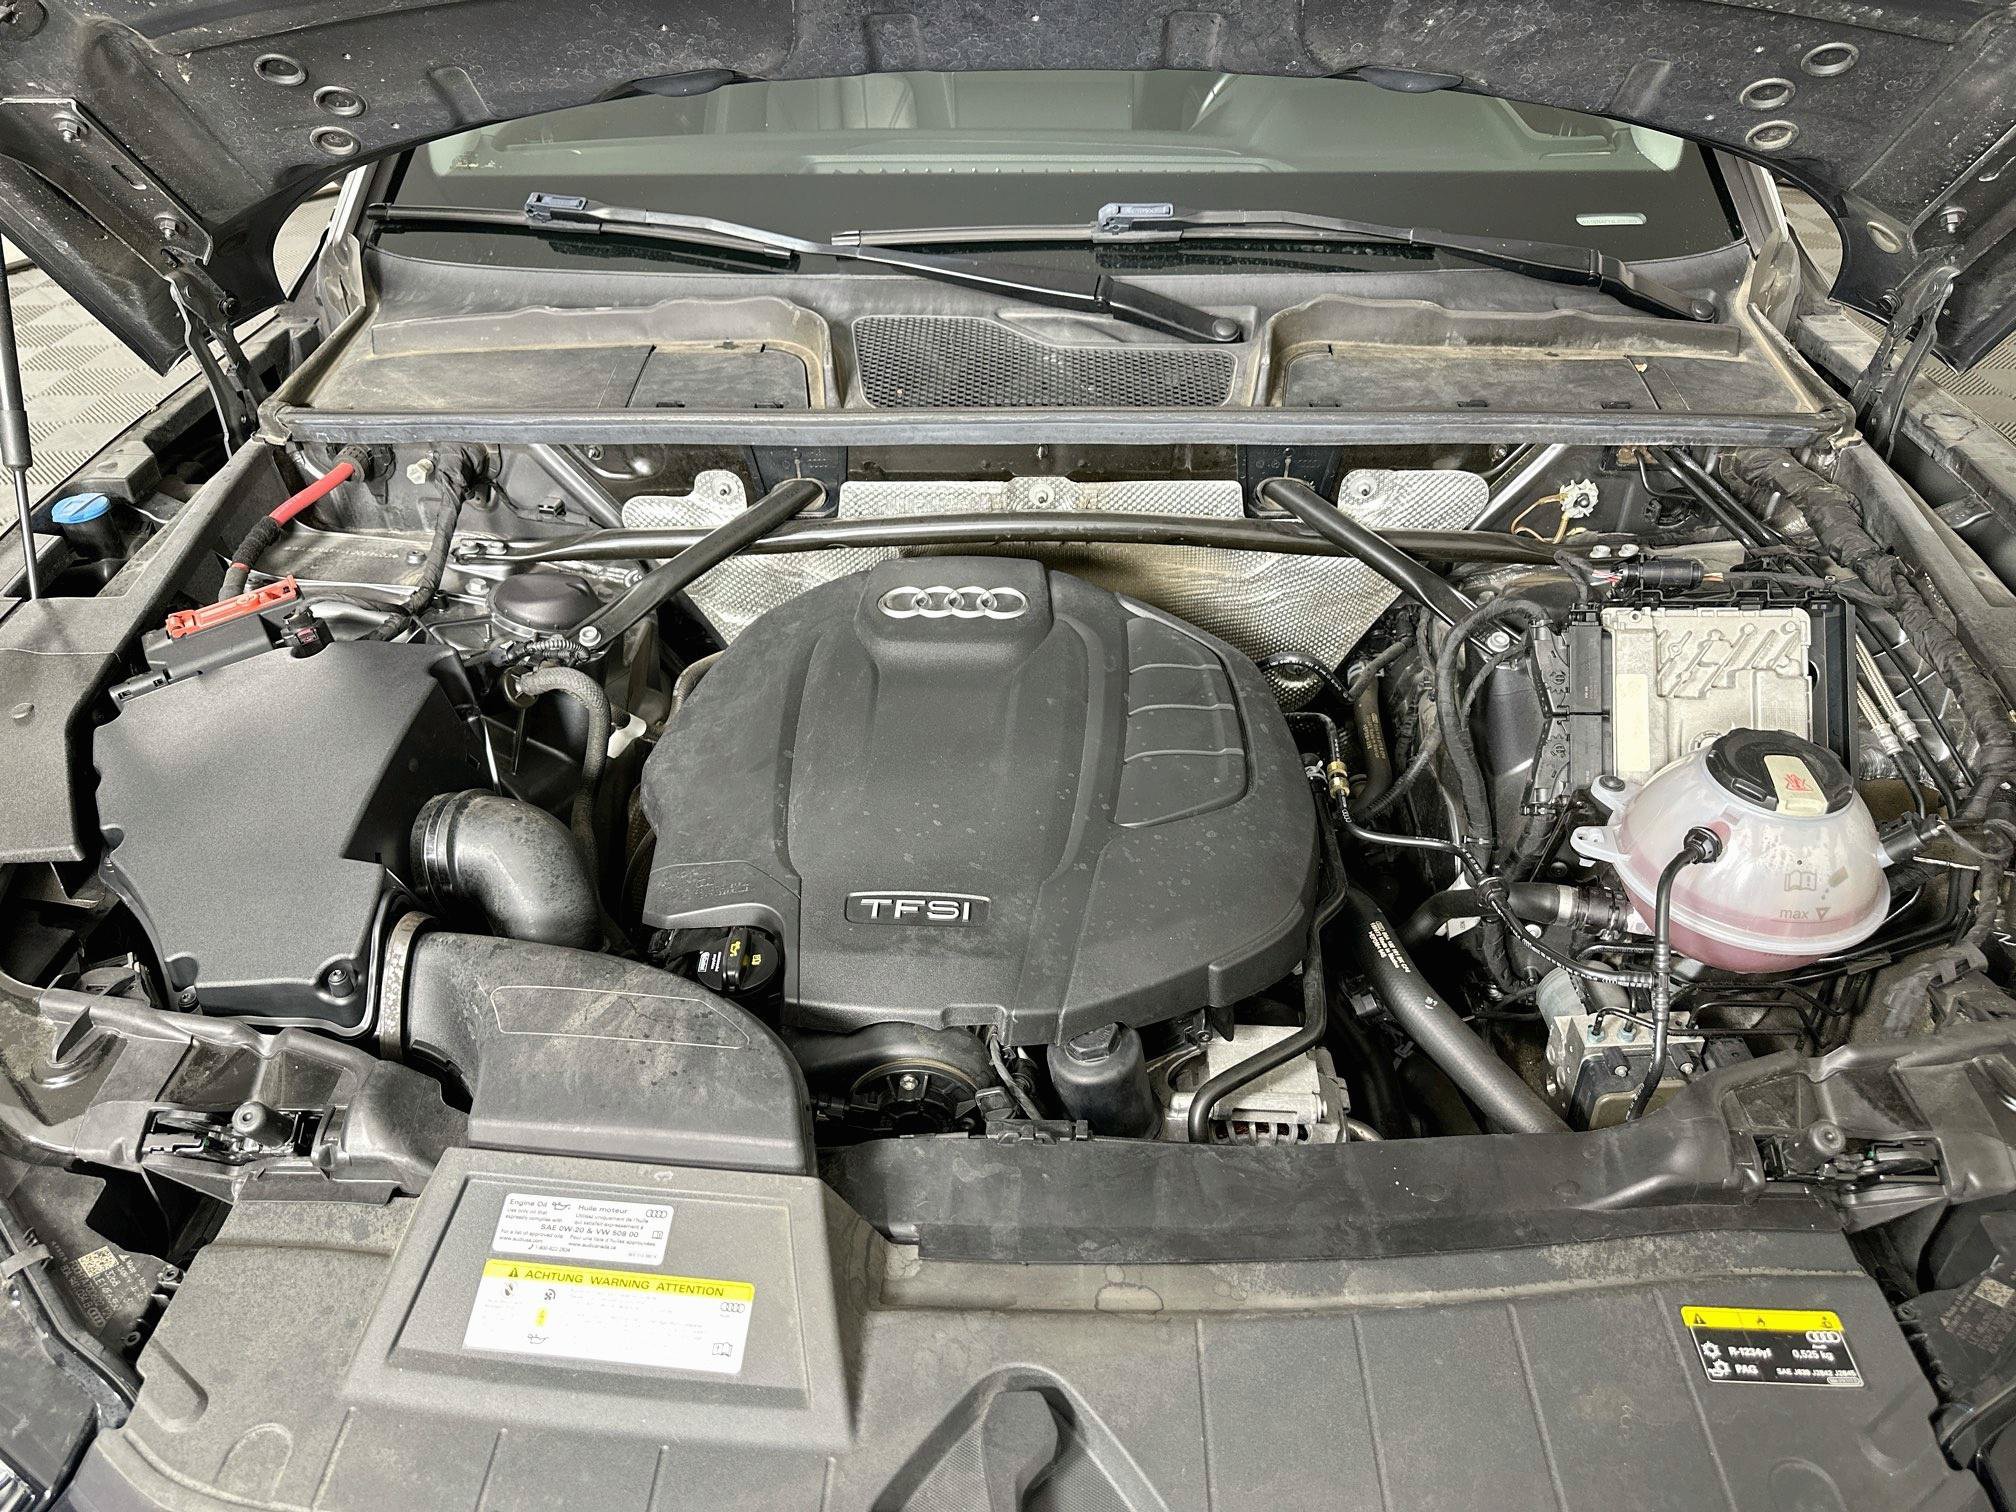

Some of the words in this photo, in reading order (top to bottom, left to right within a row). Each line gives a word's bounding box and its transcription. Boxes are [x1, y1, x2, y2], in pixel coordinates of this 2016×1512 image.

[860, 898, 971, 923] TFSI
[1779, 907, 1809, 920] max
[509, 1199, 535, 1208] Engine
[578, 1204, 598, 1212] Huile
[598, 1207, 628, 1215] moteur
[540, 1223, 557, 1231] SAE
[596, 1228, 611, 1236] VW
[524, 1269, 584, 1284] ACHTUNG
[590, 1276, 651, 1291] WARNING
[656, 1282, 725, 1297] ATTENTION
[1821, 1350, 1835, 1362] kg
[1734, 1363, 1760, 1375] PAG
[1776, 1367, 1793, 1376] SAE
